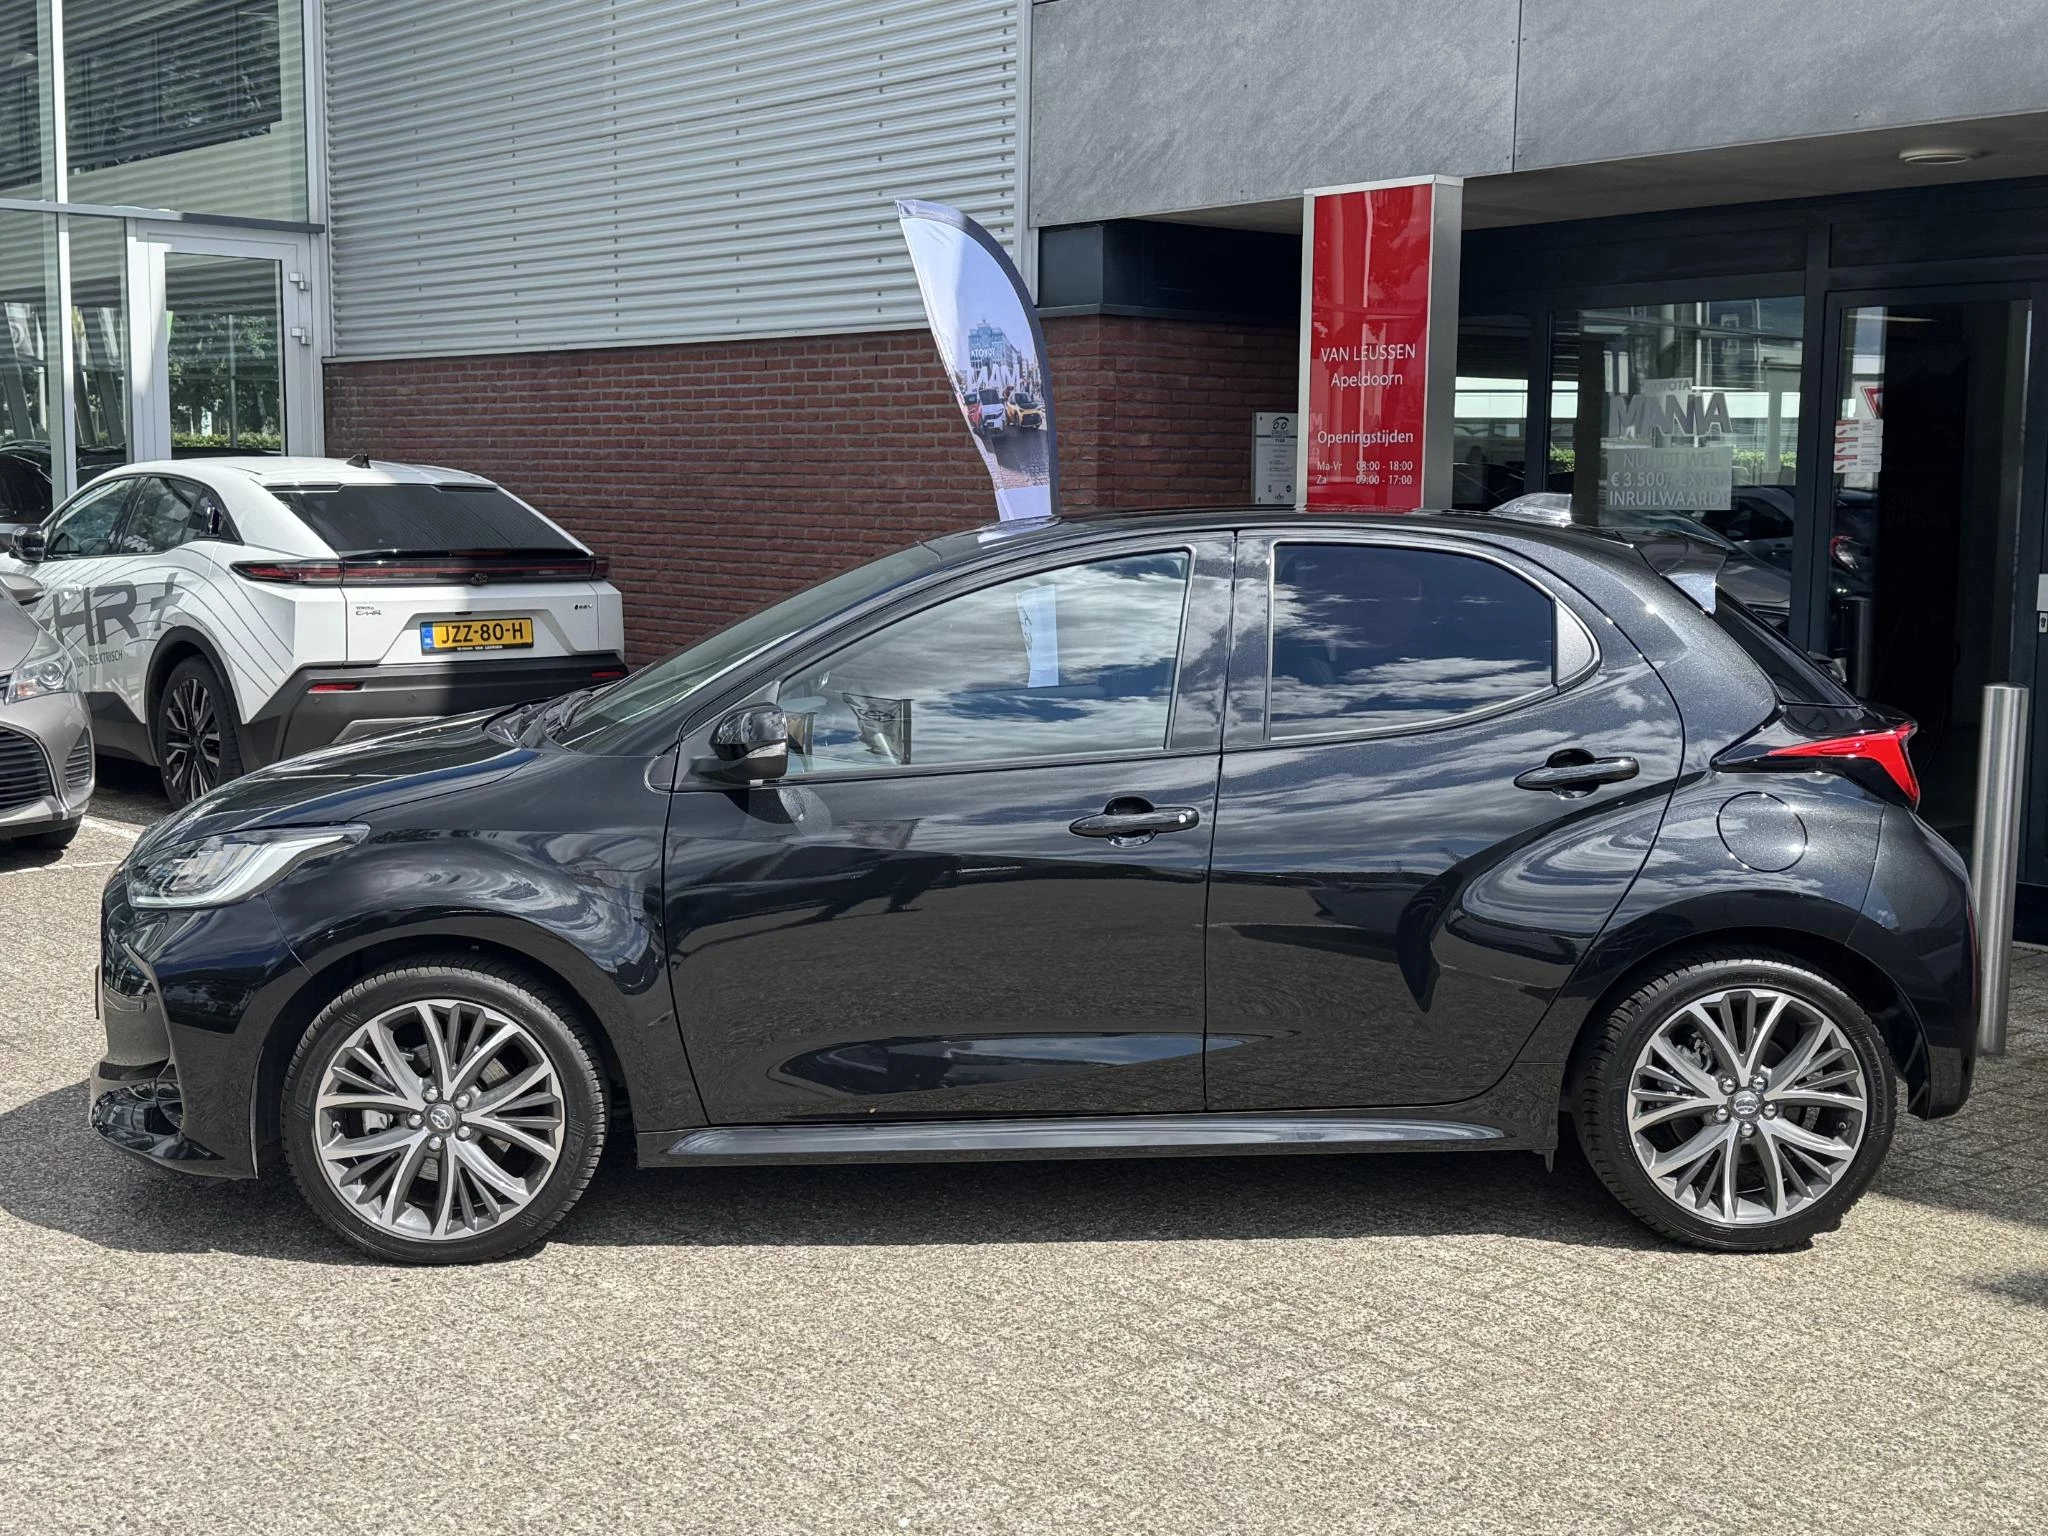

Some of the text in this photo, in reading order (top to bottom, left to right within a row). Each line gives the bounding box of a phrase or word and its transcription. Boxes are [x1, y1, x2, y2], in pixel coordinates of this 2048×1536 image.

[1321, 343, 1416, 362] VAN LEUSSEN
[1330, 371, 1403, 391] Apeldoorn
[1608, 391, 1733, 439] MANIA
[1317, 429, 1414, 447] Openingstijden
[1316, 461, 1342, 471] Ma-Vr
[1356, 461, 1380, 471] 08:00
[1389, 461, 1413, 471] 18:00
[1316, 475, 1328, 485] Za
[1355, 475, 1380, 485] 09:00
[1388, 475, 1413, 485] 17:00
[1610, 472, 1620, 487] €
[441, 622, 524, 644] JZZ-80-H
[88, 648, 123, 666] ELEKTRISCH
